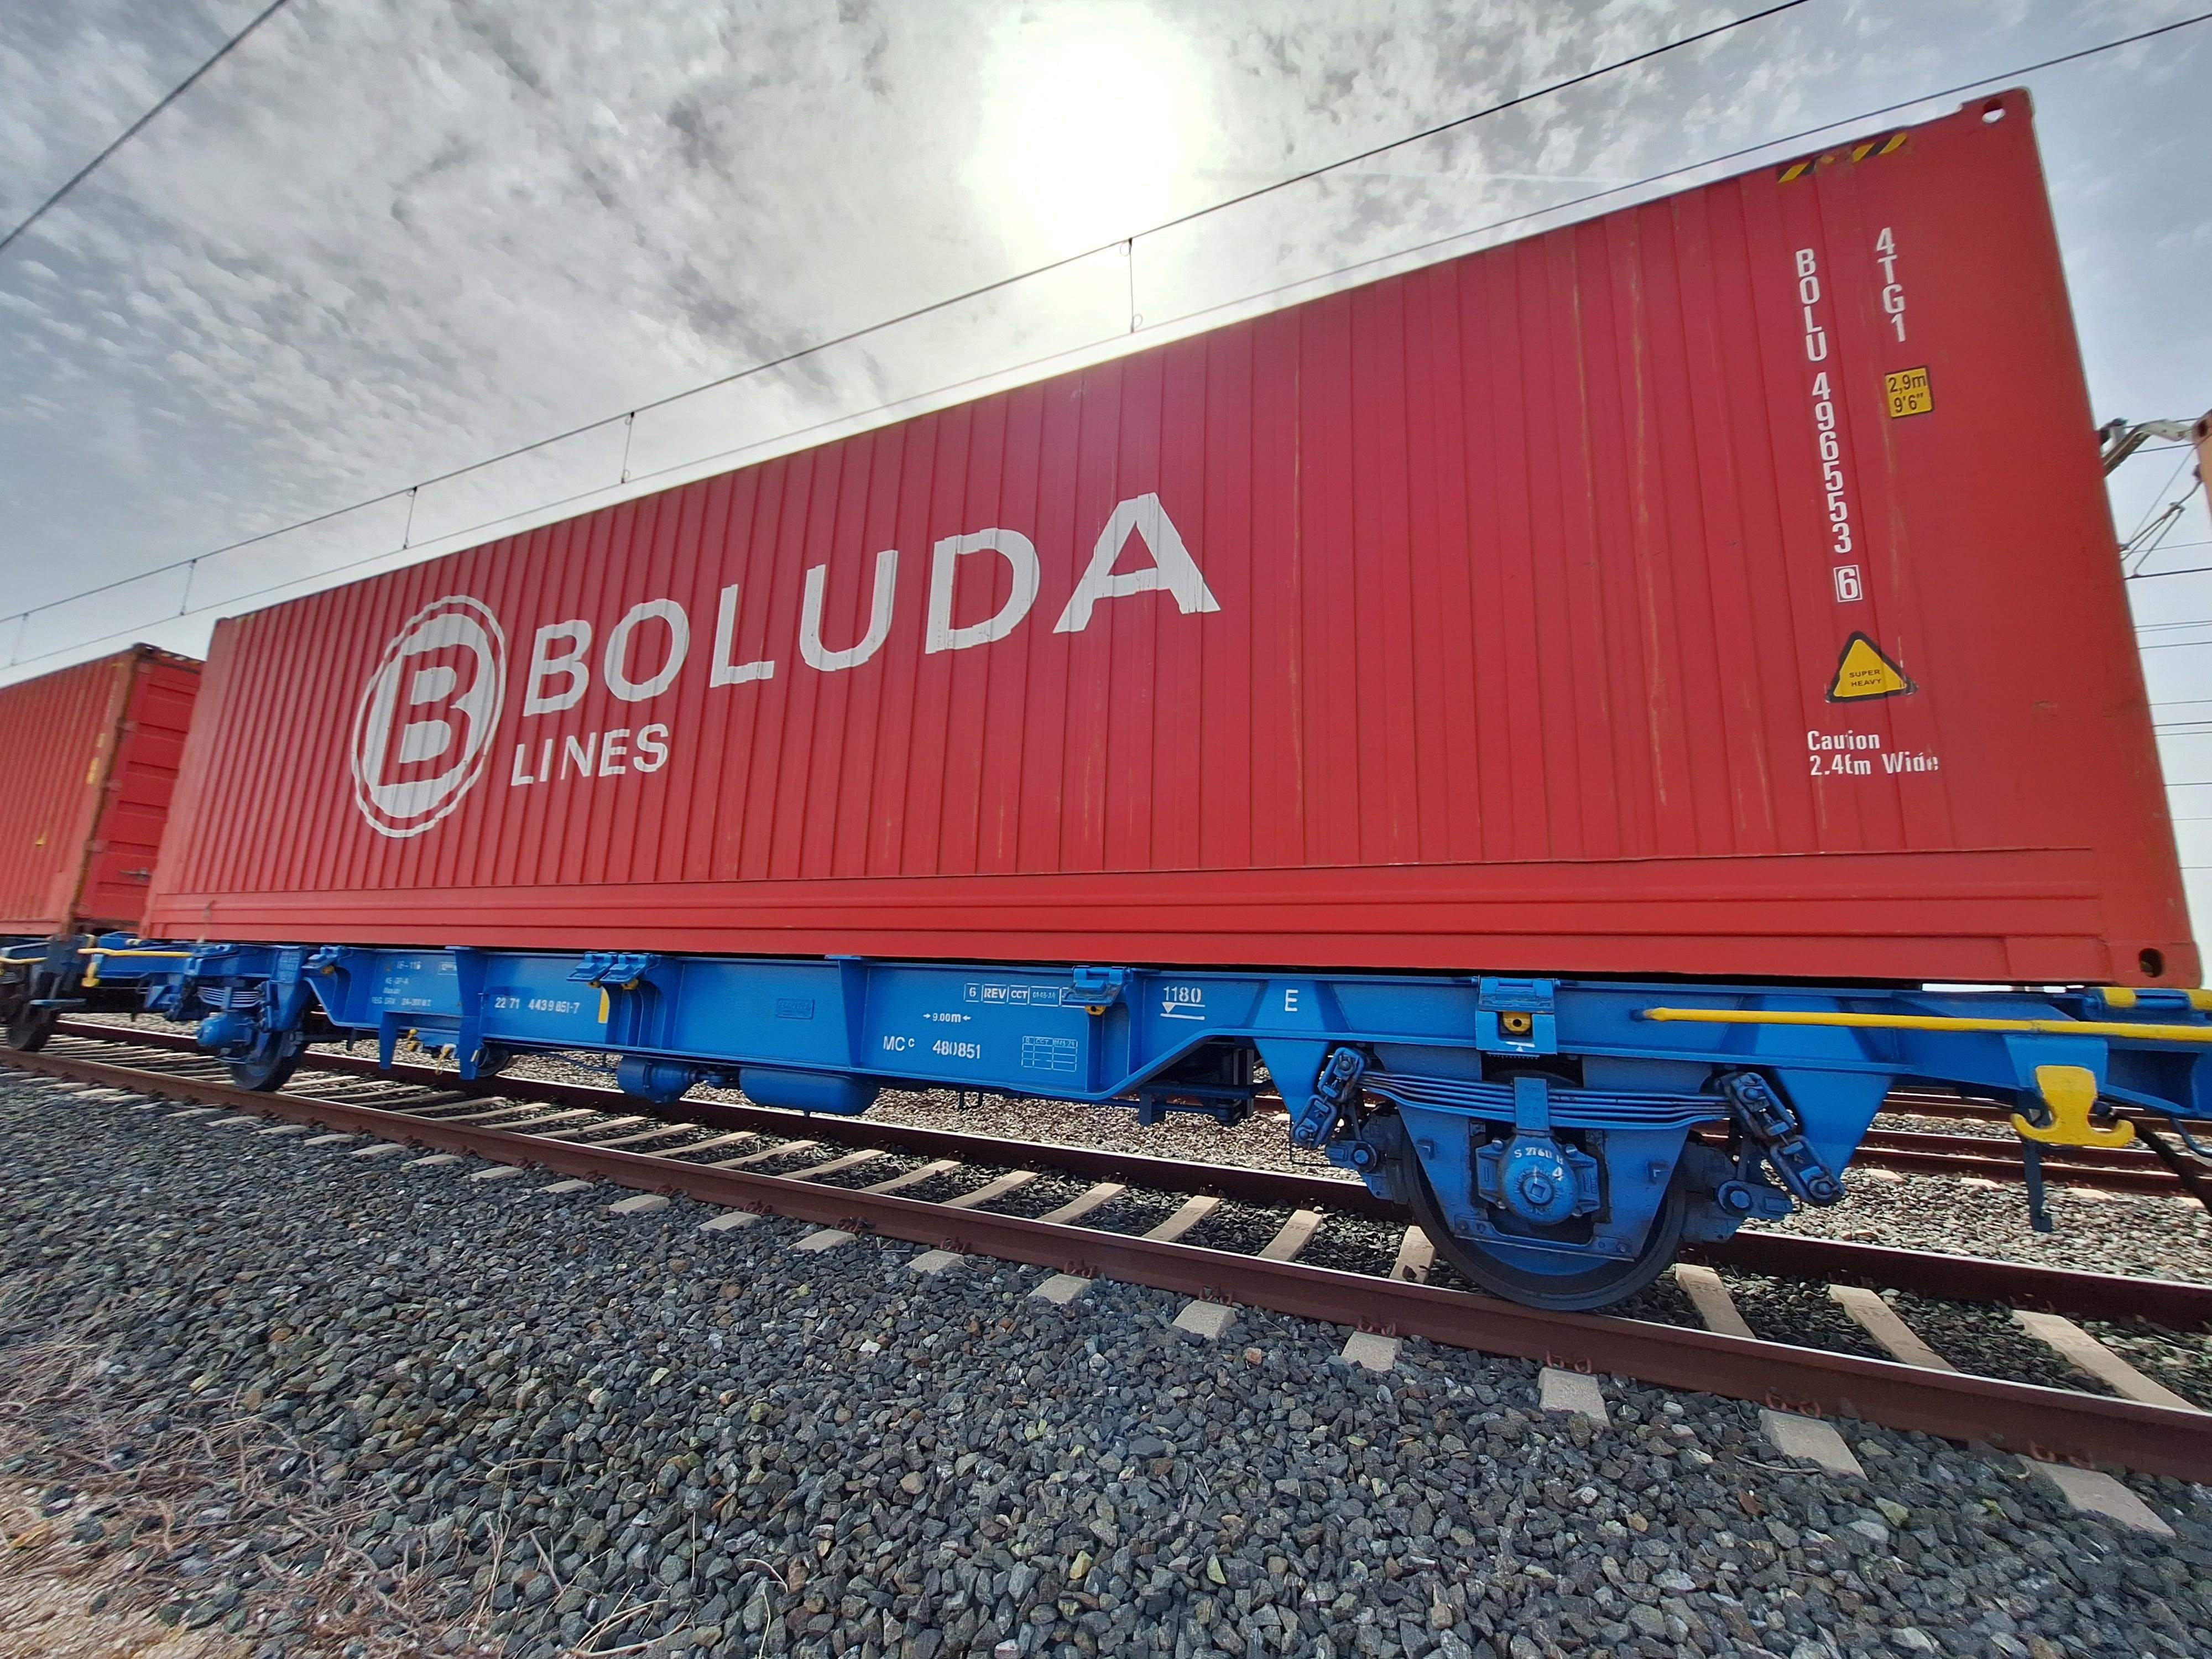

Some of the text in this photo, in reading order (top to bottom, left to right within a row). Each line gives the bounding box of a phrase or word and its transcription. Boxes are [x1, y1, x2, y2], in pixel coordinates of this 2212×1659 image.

[1876, 227, 1906, 342] 4TG1
[1796, 248, 1859, 600] BOLU 496553 6
[523, 492, 1221, 717] BOLUDA
[1849, 669, 1880, 678] SUPER
[1851, 679, 1881, 687] HEAVY
[510, 723, 669, 786] LINES
[969, 987, 977, 997] 6
[983, 988, 1006, 999] REV
[1011, 990, 1028, 999] CCT
[1163, 986, 1202, 1003] 1180
[1285, 989, 1298, 1012] E
[494, 997, 506, 1009] 22
[509, 998, 520, 1009] 71
[528, 999, 554, 1011] 4439
[932, 1013, 962, 1023] 9.00m
[932, 1040, 980, 1059] 480851
